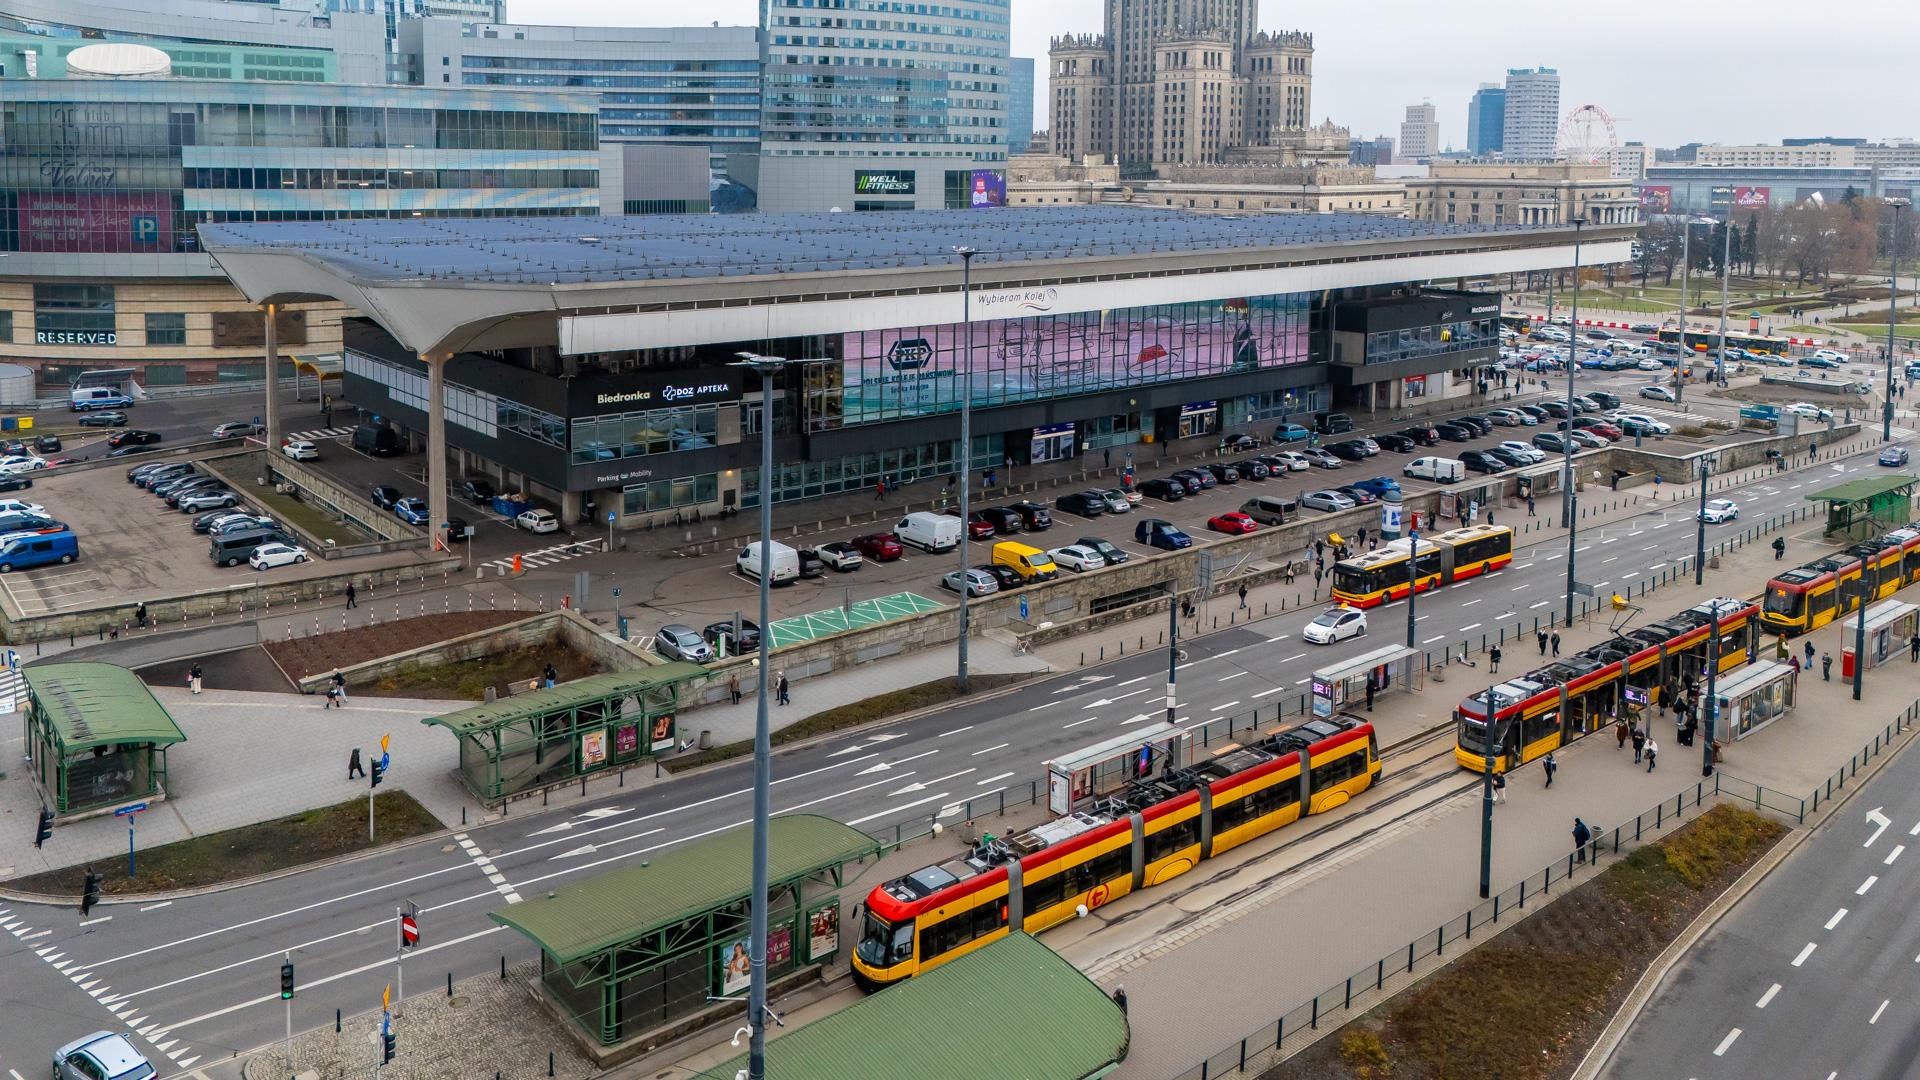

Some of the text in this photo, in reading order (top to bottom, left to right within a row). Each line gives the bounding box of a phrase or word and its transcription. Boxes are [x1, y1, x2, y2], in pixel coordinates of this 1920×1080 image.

[868, 175, 898, 183] WELL
[866, 182, 910, 190] FITNESS
[139, 219, 155, 239] P
[978, 290, 1046, 306] Wybieram Kolej
[37, 331, 117, 344] RESERVED
[895, 347, 927, 361] PKP
[676, 384, 729, 395] DOZ APTEKA
[597, 391, 651, 404] Biedronka
[597, 474, 619, 483] Parking
[629, 470, 652, 478] Mobility
